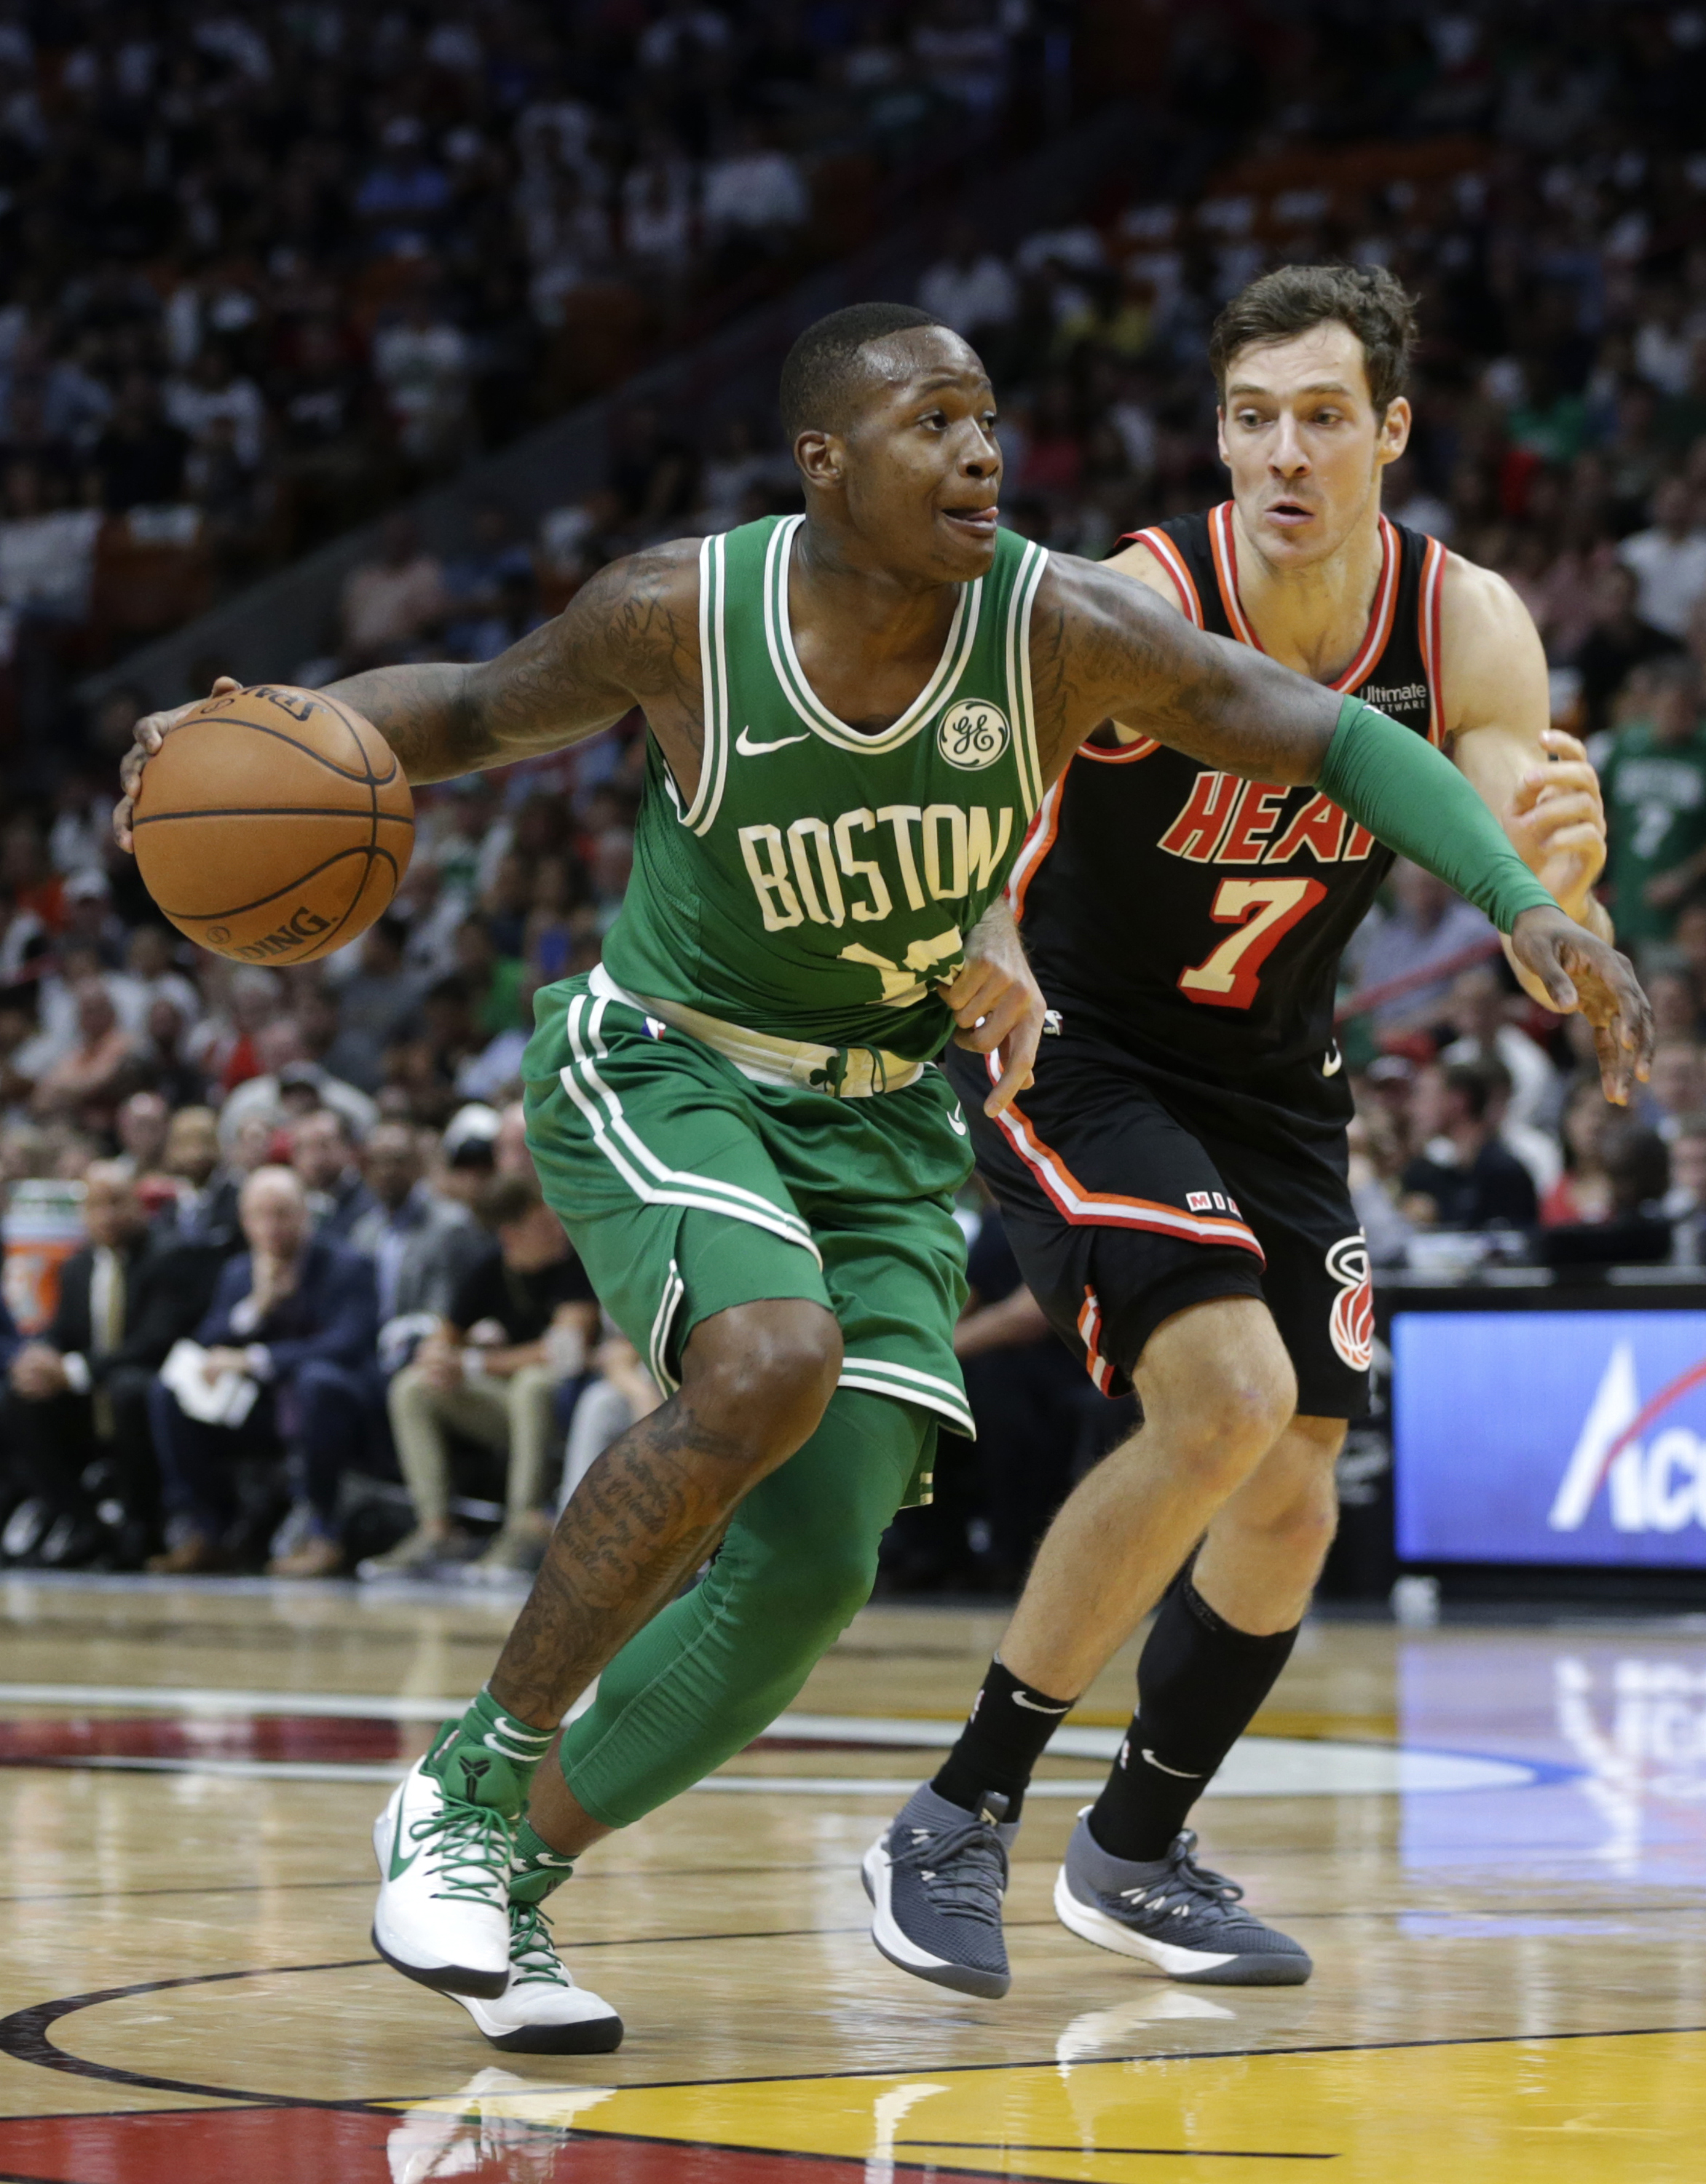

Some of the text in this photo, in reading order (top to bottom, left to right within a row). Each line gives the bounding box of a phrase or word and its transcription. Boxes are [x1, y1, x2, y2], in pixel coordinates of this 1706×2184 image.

[1360, 683, 1426, 703] Ultimate
[1373, 699, 1426, 713] FTWARE
[952, 714, 995, 755] GE
[738, 804, 1013, 932] BOSTON
[1177, 877, 1328, 1010] 7
